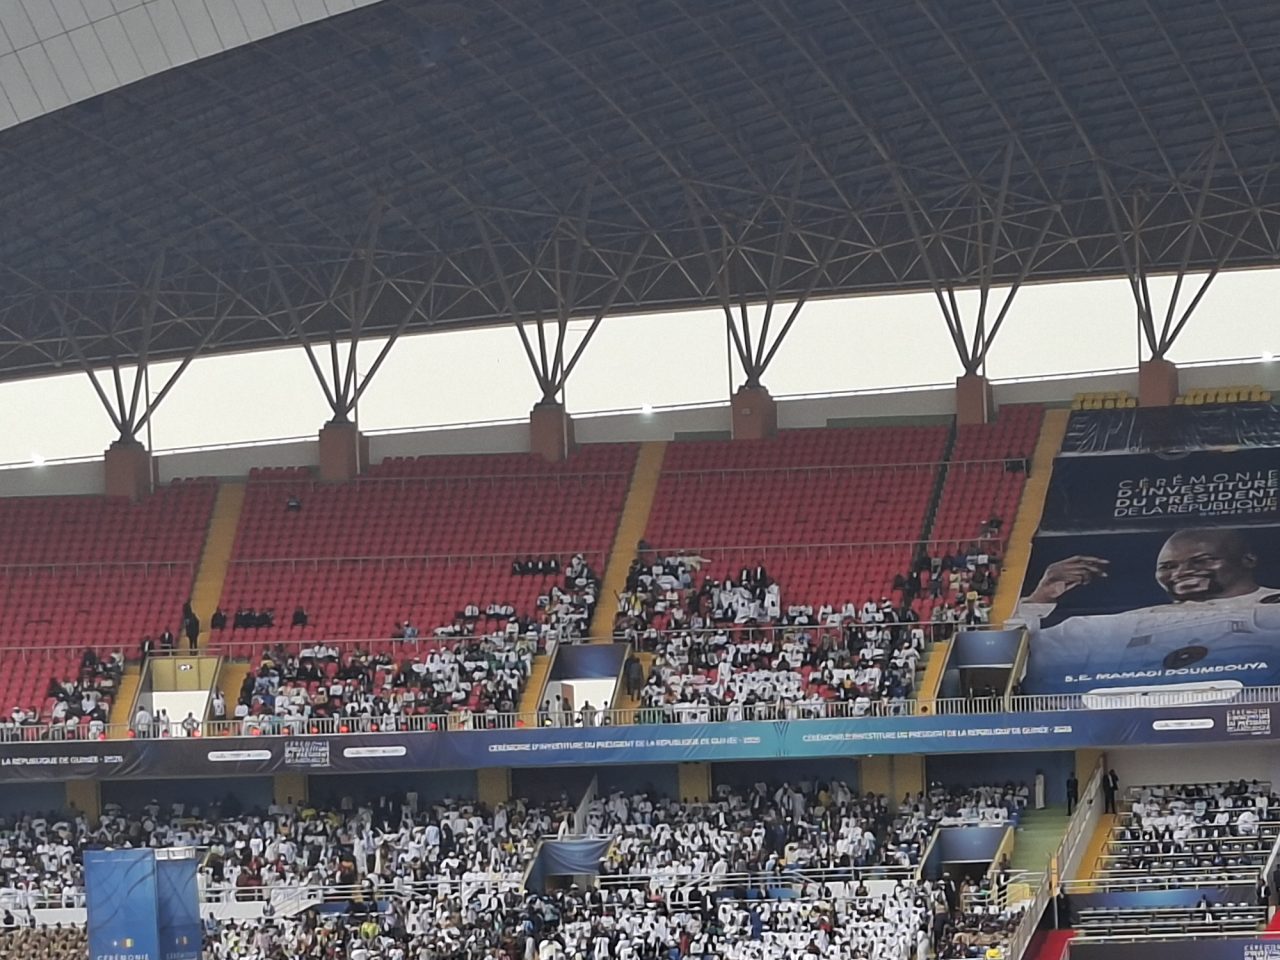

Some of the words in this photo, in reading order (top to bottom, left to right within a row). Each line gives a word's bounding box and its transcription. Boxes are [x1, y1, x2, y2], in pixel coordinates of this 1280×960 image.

[1117, 479, 1278, 498] D'INVESTITURE
[1119, 469, 1278, 489] CÉRÉMONIE
[1114, 507, 1139, 517] DE
[1142, 506, 1163, 515] LA
[1167, 497, 1277, 513] RÉPUBLIQUE
[1116, 498, 1146, 508] DU
[1155, 487, 1278, 505] PRÉSIDENT
[1095, 669, 1162, 681] MAMADI
